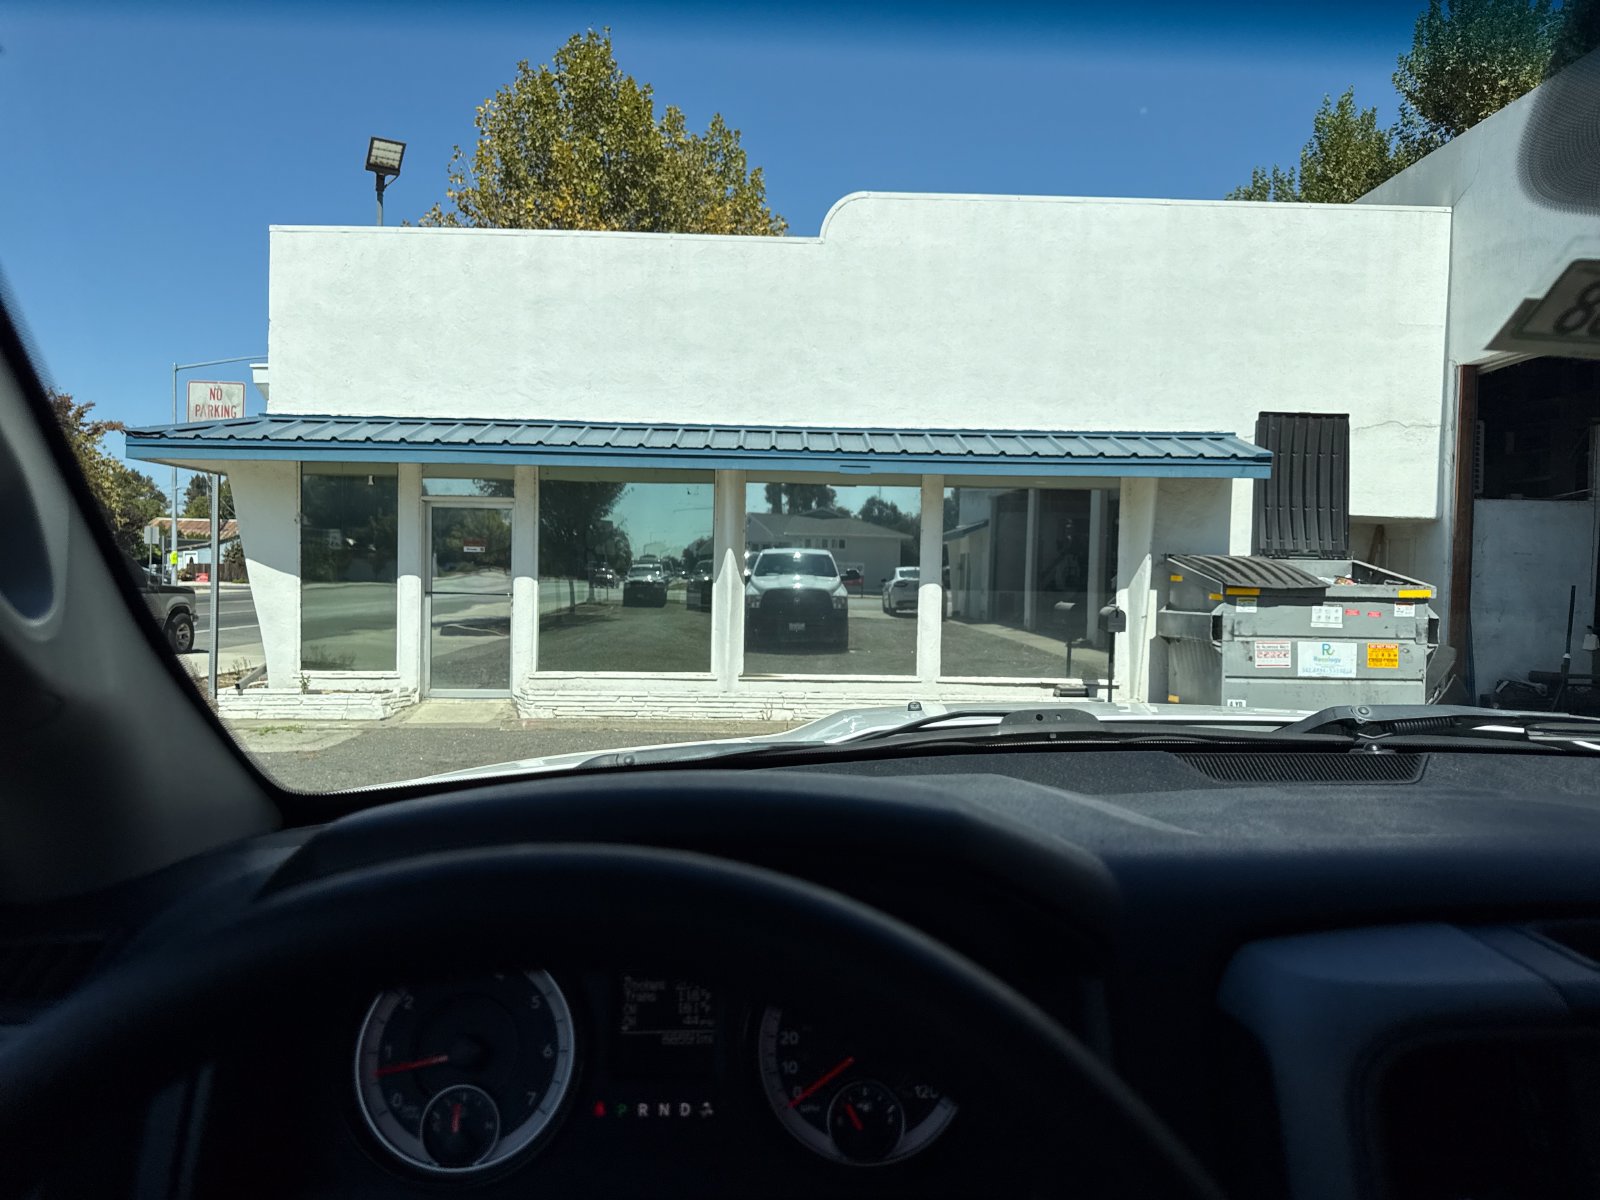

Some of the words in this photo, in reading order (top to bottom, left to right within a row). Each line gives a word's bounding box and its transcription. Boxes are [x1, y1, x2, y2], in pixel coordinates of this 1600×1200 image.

[210, 386, 223, 401] NO
[195, 404, 237, 419] PARKING
[780, 1031, 800, 1046] 20
[543, 1044, 553, 1059] 6
[782, 1061, 798, 1074] 10
[638, 1102, 649, 1117] R
[658, 1102, 671, 1117] N
[680, 1102, 691, 1117] D
